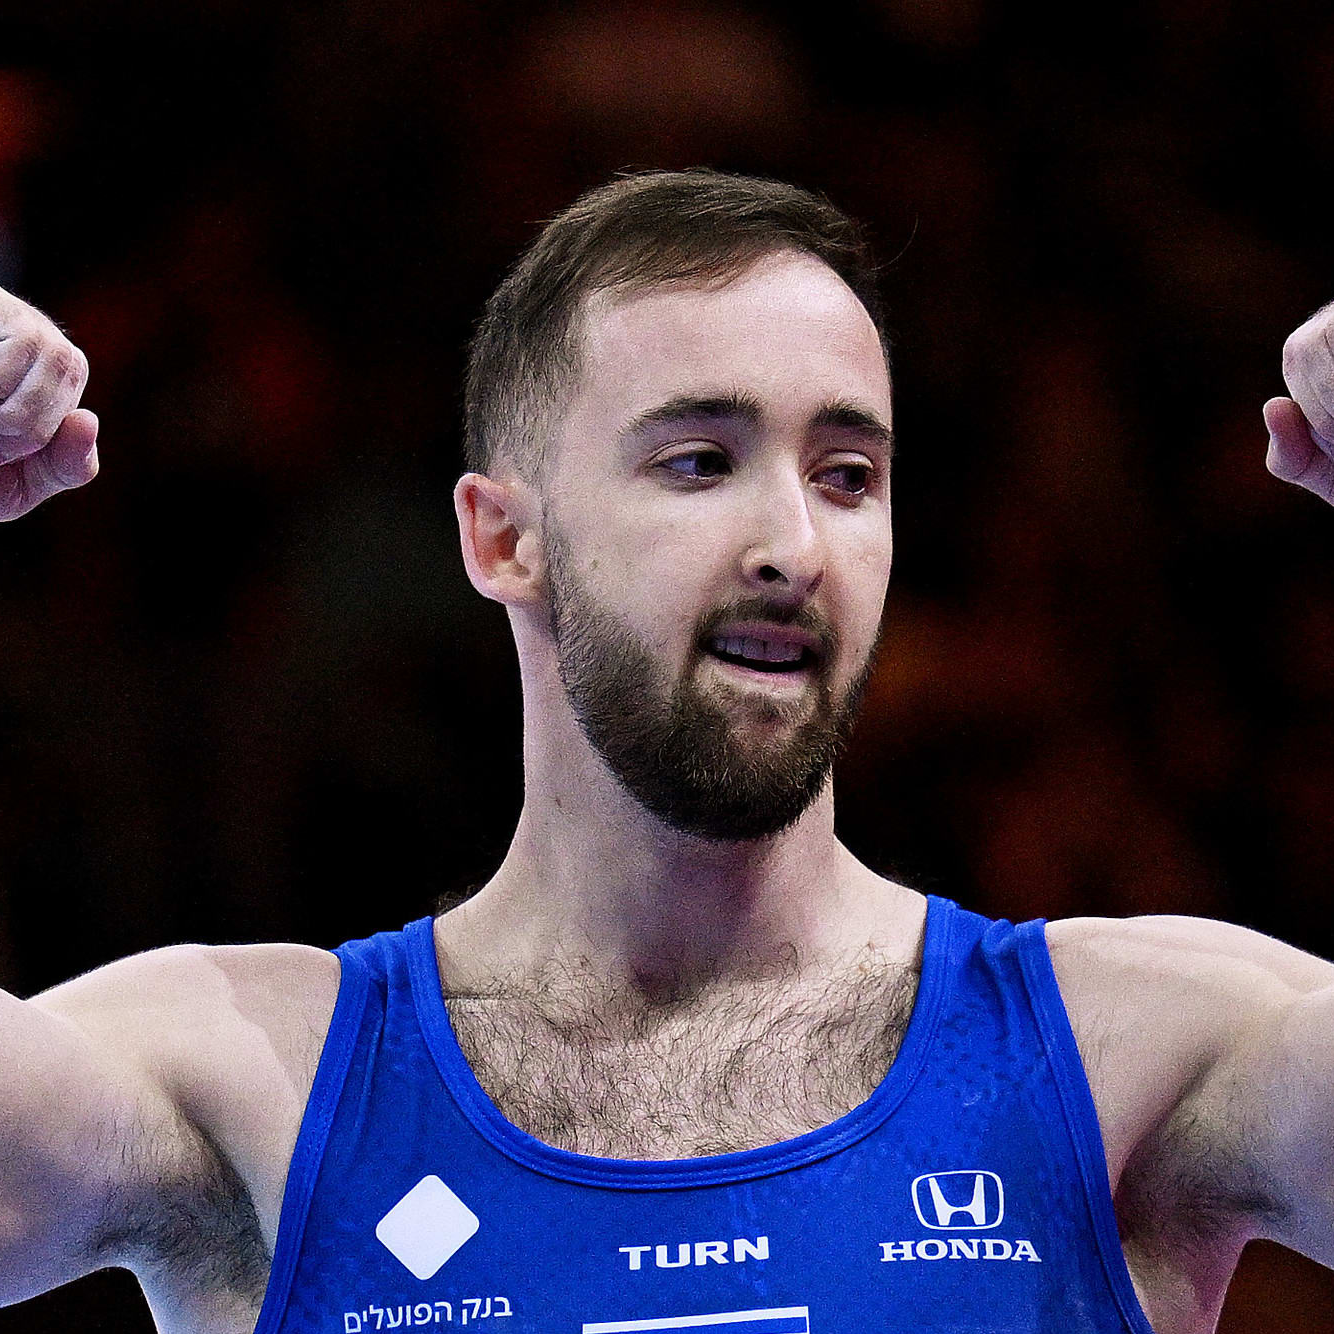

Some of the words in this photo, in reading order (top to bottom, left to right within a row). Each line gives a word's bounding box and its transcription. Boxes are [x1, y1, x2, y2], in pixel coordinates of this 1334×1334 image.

[618, 1236, 770, 1270] TURN
[879, 1239, 1042, 1262] HONDA
[344, 1301, 452, 1334] הפועלים
[462, 1297, 513, 1325] בנק
